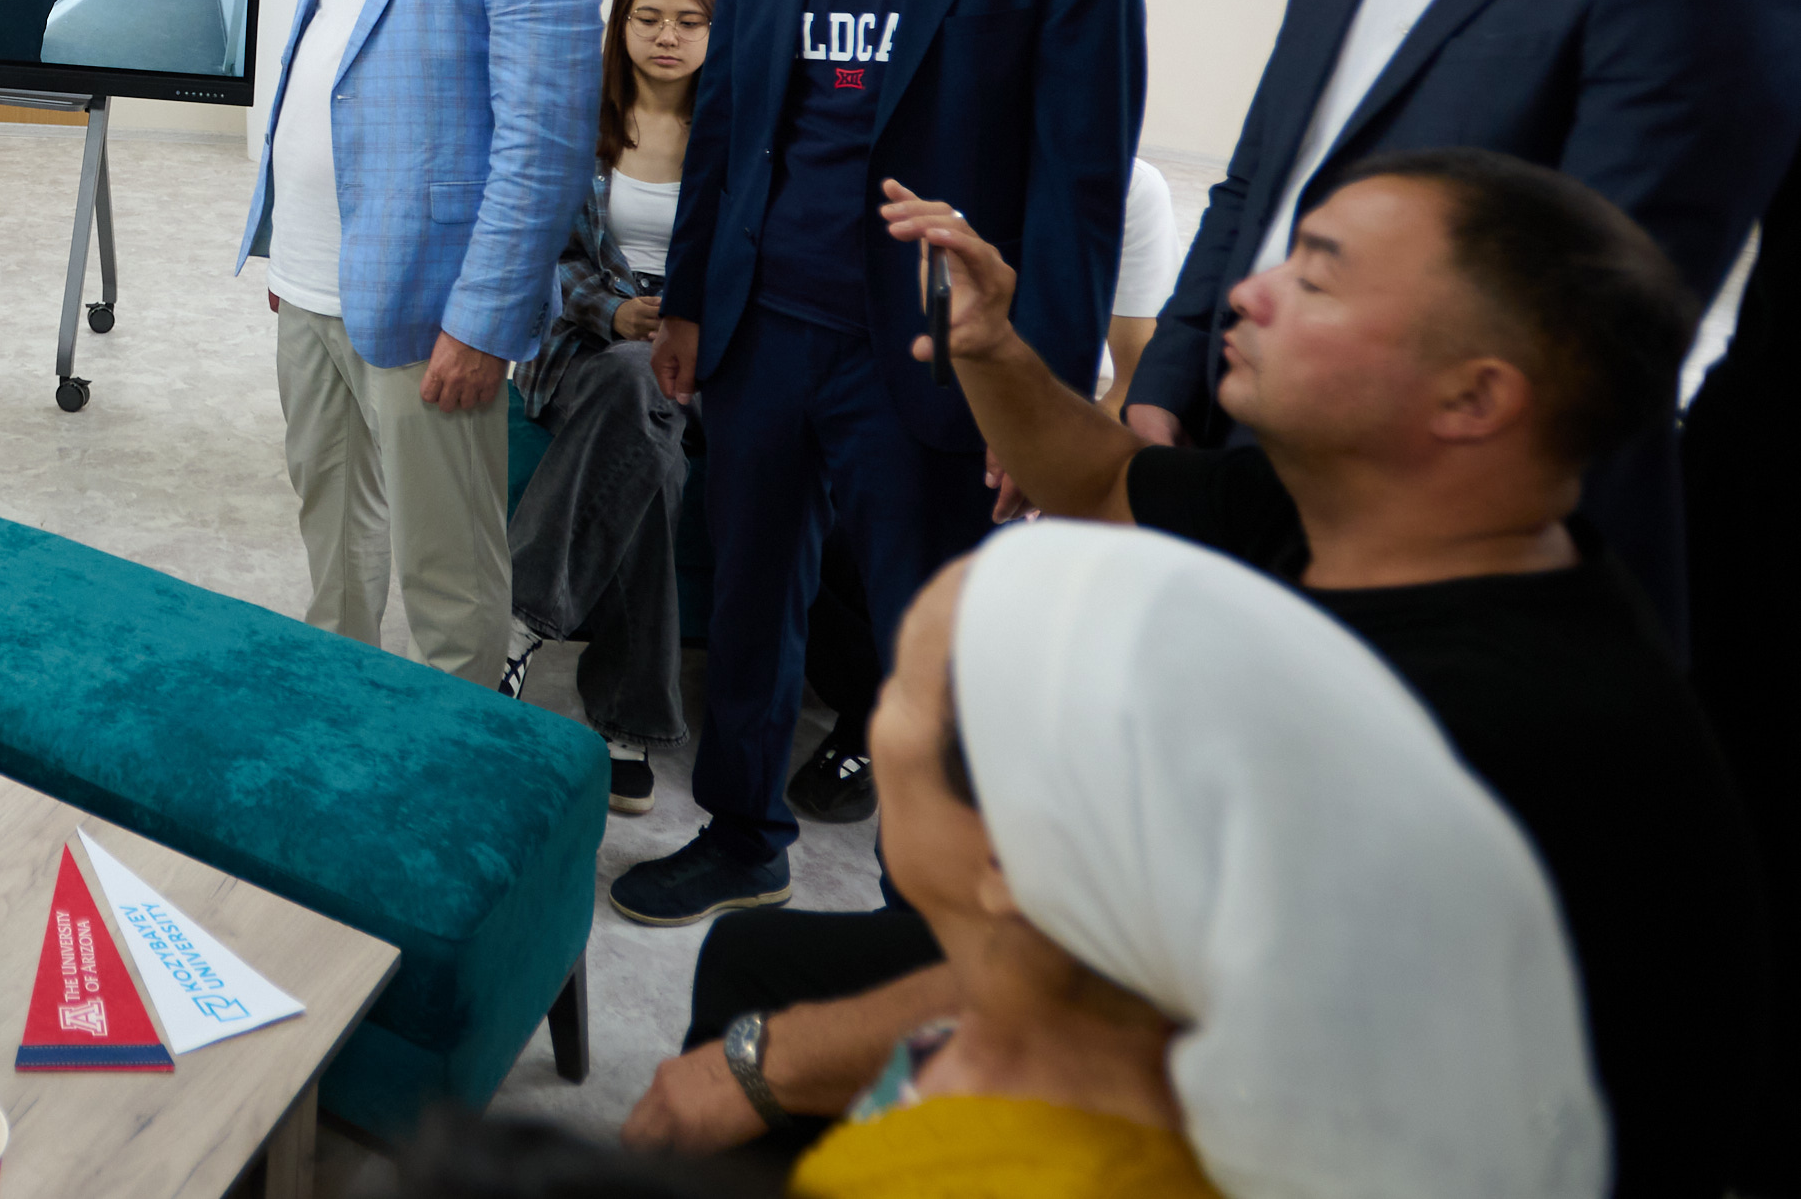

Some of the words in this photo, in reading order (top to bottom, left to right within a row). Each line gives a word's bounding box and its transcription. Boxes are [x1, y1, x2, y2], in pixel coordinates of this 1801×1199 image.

[56, 910, 77, 976] UNIVERSITY
[77, 919, 97, 974] ARIZONA
[119, 905, 202, 993] KOZYBAYEV
[141, 902, 225, 990] UNIVERSITY
[64, 978, 81, 1002] THE
[85, 974, 100, 993] OF
